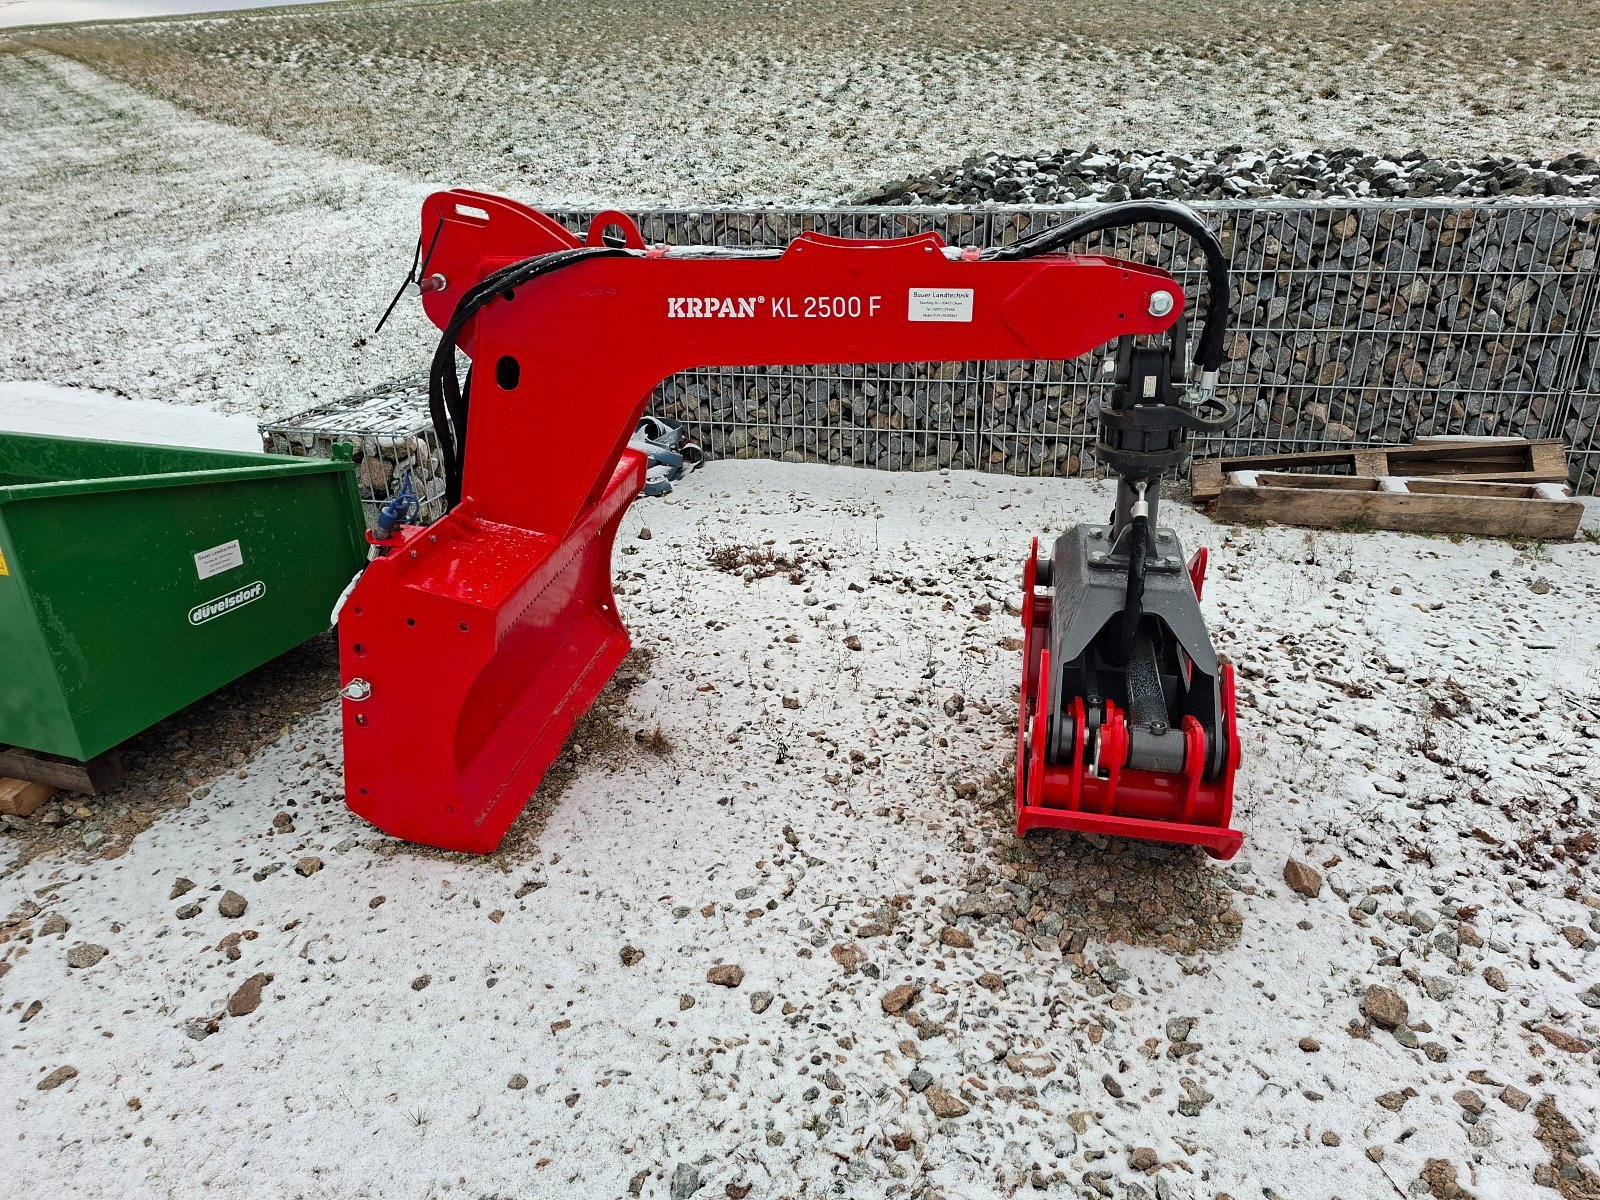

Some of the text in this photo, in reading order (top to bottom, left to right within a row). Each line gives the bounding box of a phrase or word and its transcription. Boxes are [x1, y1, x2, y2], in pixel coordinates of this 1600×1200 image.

[772, 297, 799, 318] KL
[804, 296, 861, 318] 2500
[869, 296, 882, 317] F
[192, 583, 262, 622] düvelsdorf
